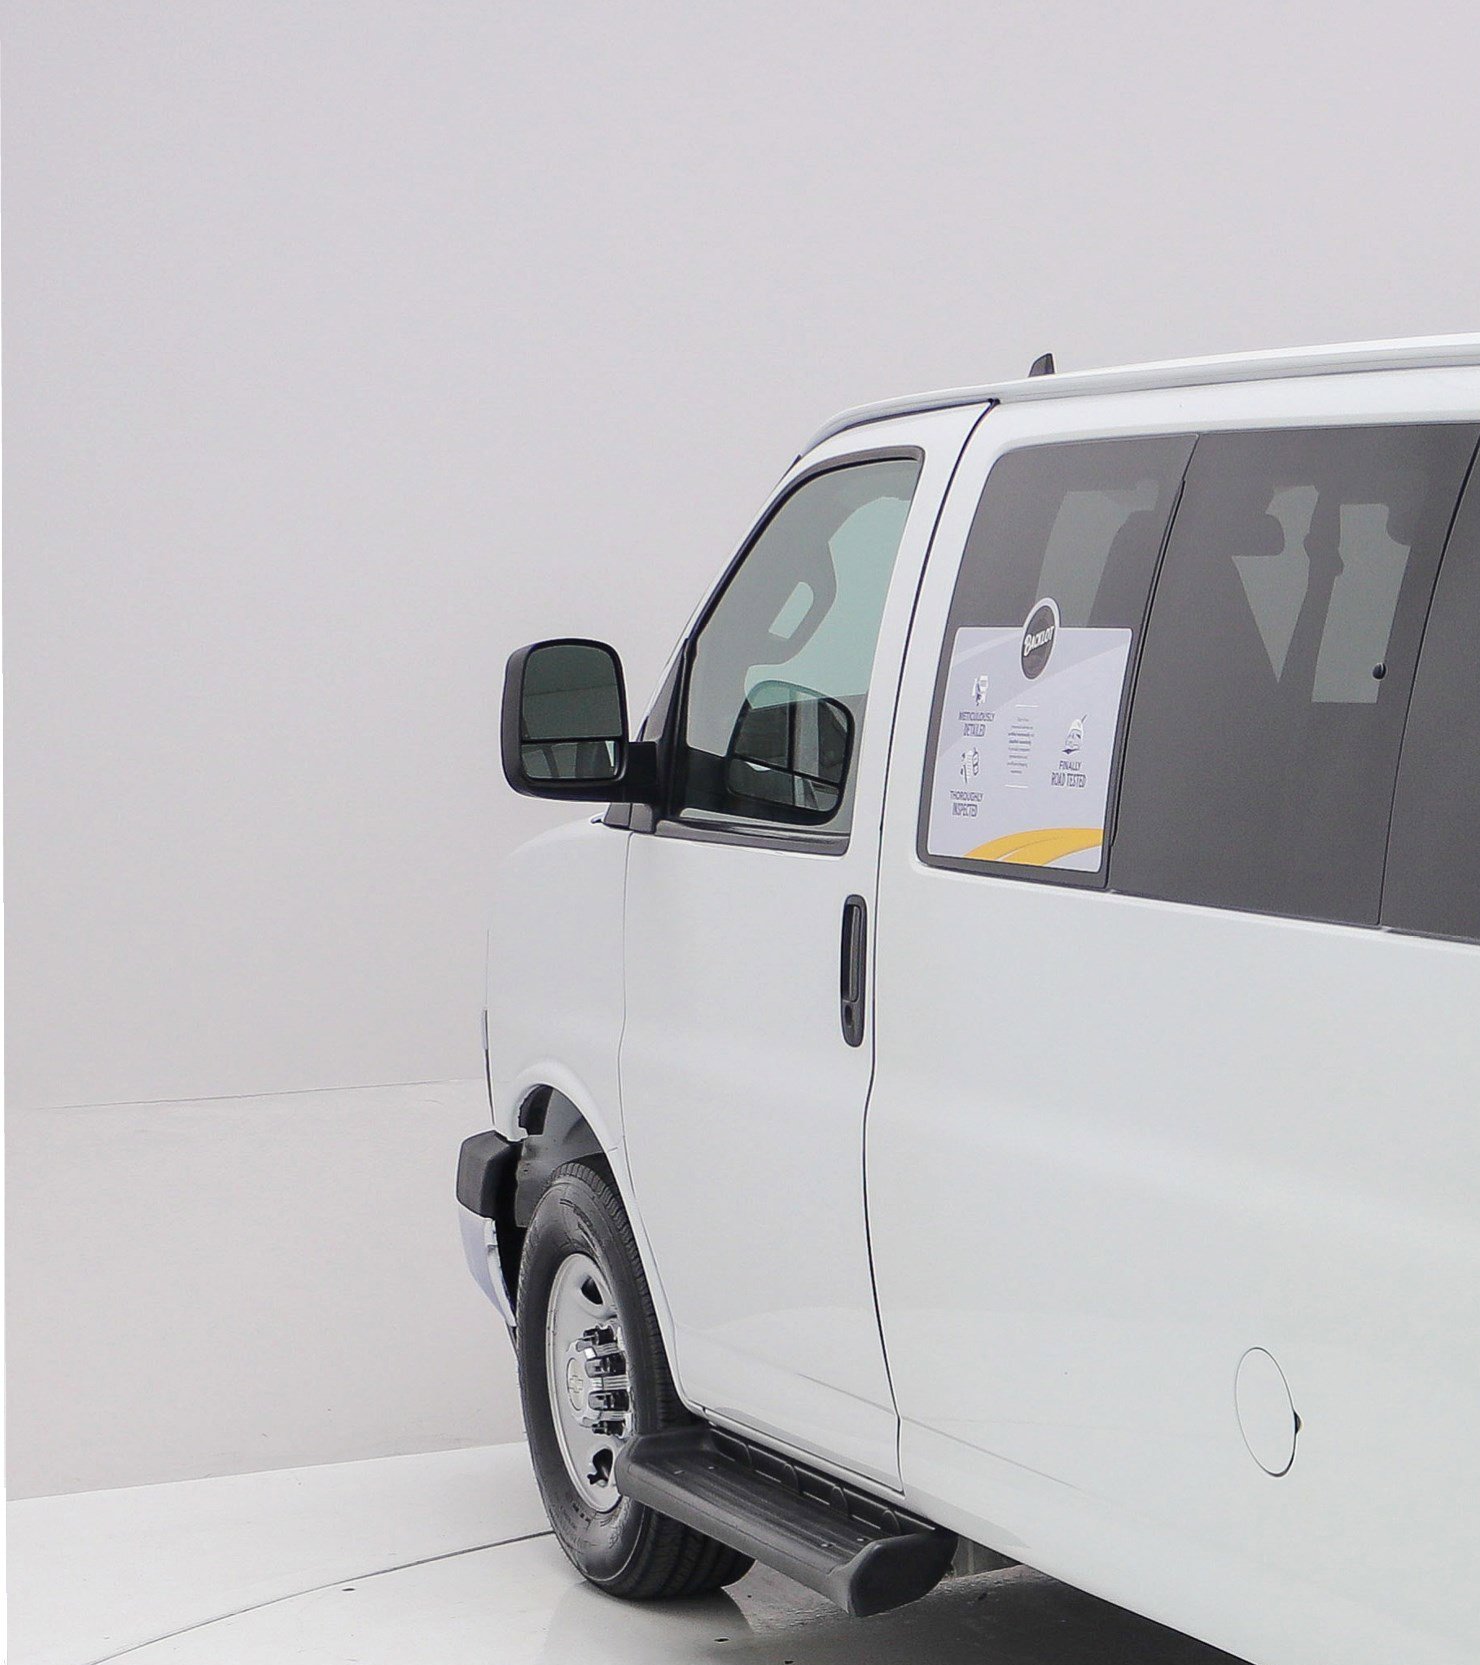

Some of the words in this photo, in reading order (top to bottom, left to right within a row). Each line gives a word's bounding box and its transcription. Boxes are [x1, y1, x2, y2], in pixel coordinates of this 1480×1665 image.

[1023, 625, 1056, 656] BACKLOT
[963, 723, 987, 737] DETAILED
[1059, 760, 1083, 771] FINALLY
[1051, 772, 1066, 787] ROAD
[1066, 773, 1087, 788] TESTED
[952, 803, 978, 817] INSPECTED
